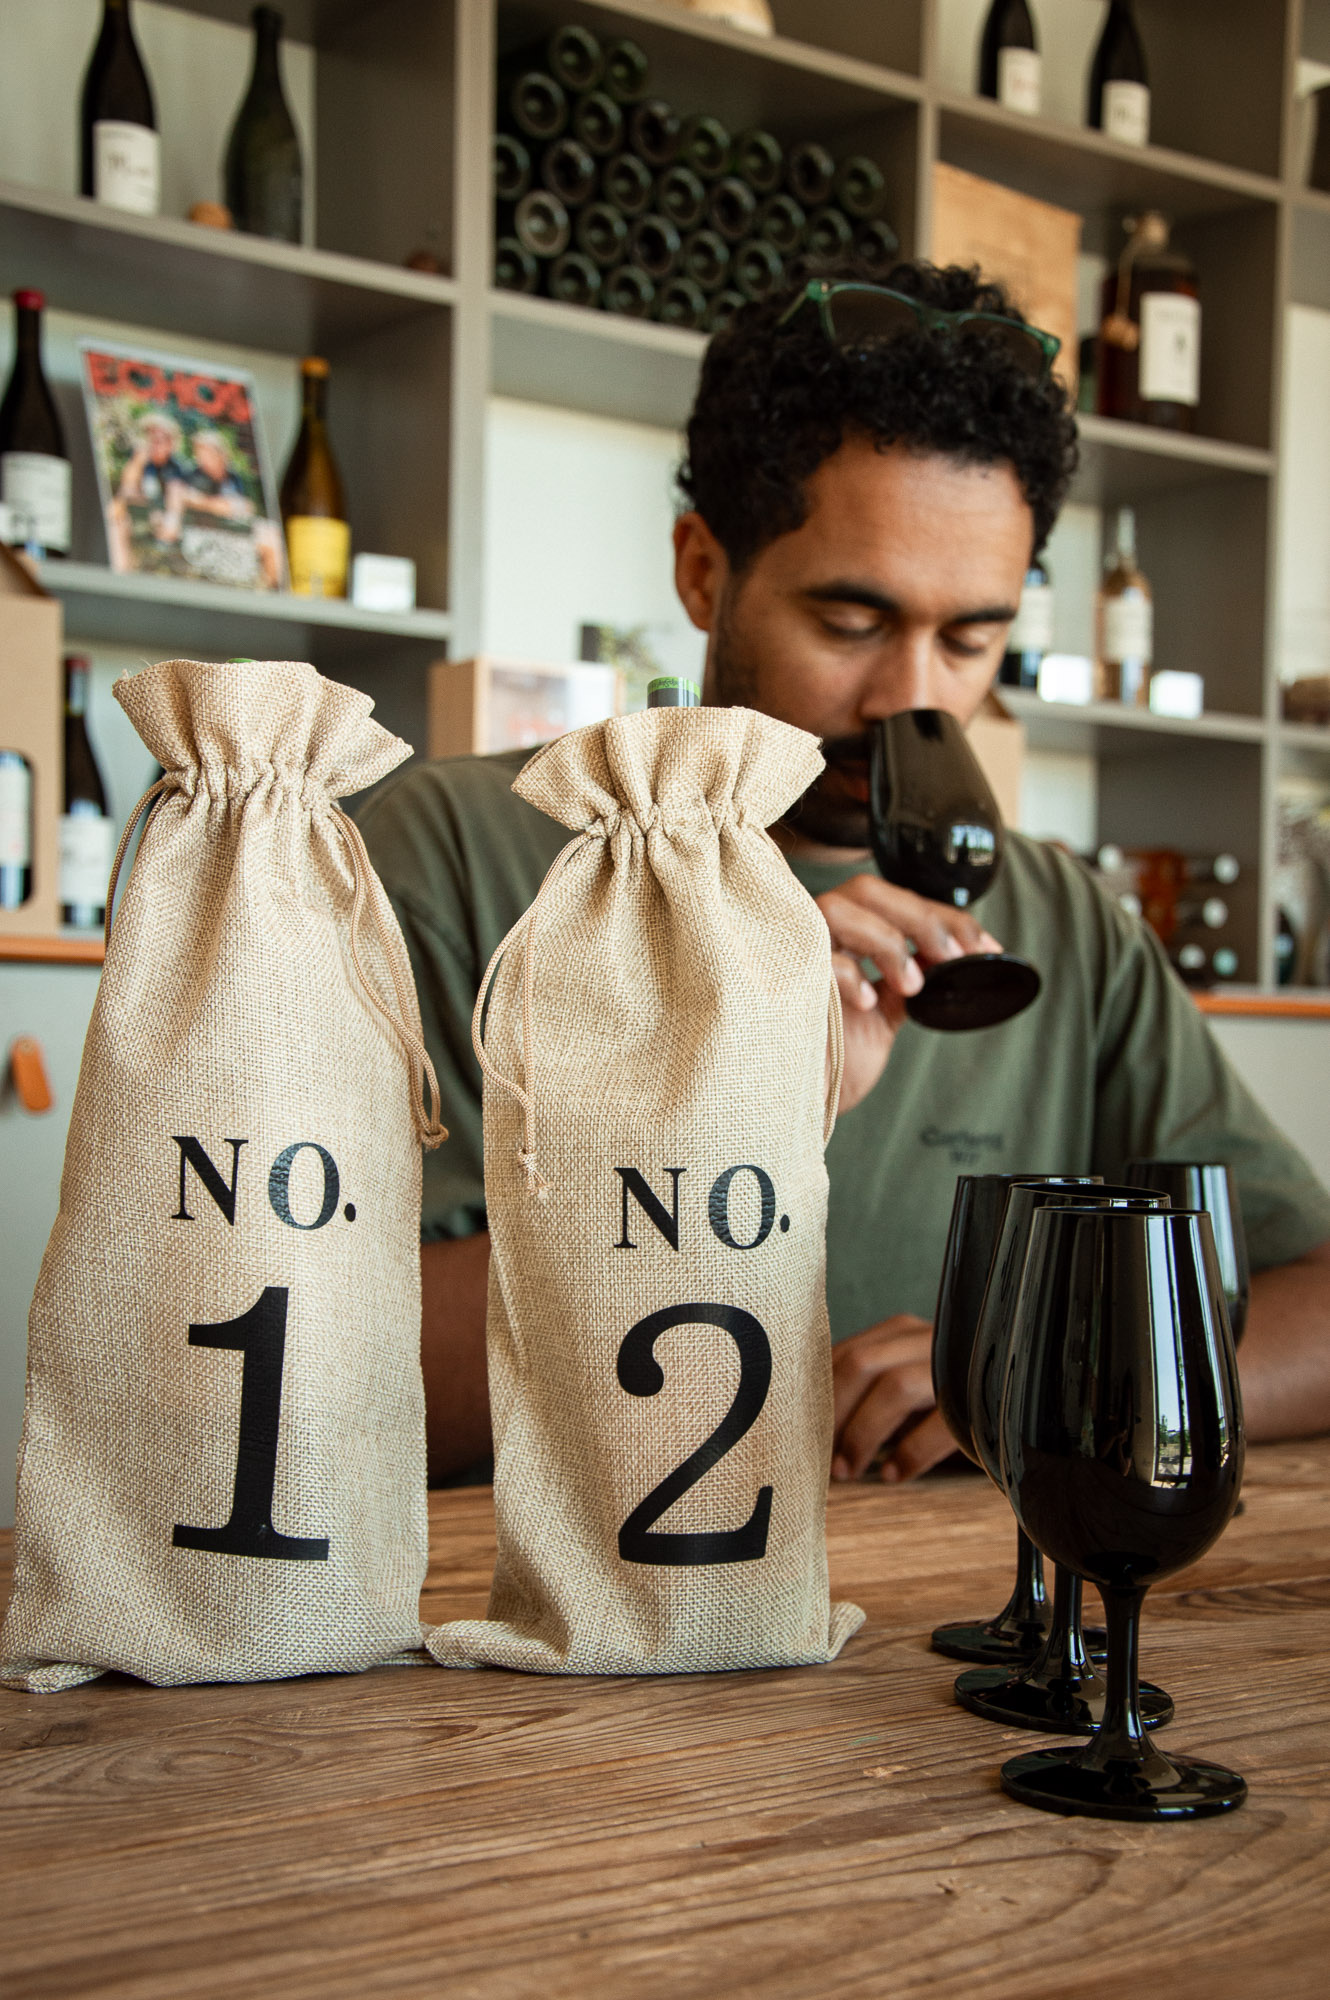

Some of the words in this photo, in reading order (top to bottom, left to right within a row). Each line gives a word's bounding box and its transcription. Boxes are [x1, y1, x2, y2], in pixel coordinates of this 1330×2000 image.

[171, 1136, 357, 1230] NO.
[613, 1164, 791, 1251] NO.
[172, 1286, 330, 1561] 1
[616, 1302, 774, 1566] 2
